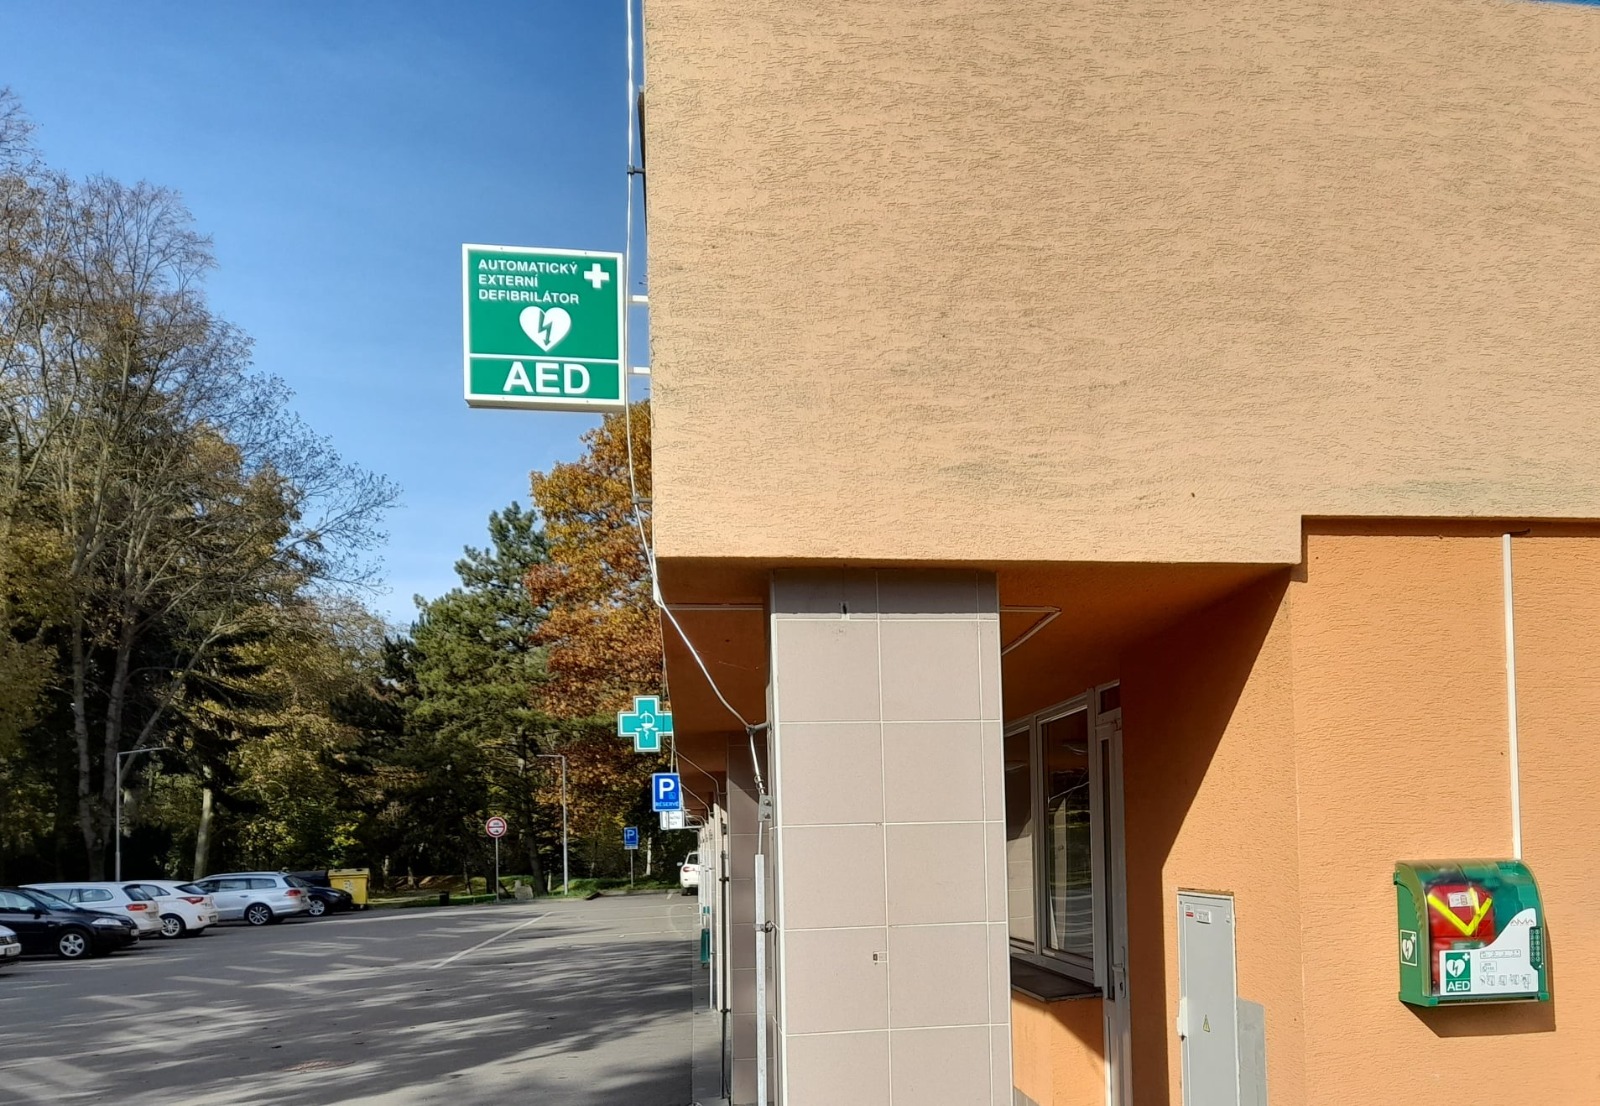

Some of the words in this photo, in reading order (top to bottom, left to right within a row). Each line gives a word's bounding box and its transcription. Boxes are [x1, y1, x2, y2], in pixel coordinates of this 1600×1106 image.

[478, 259, 577, 274] AUTOMATICKÝ
[478, 274, 538, 287] EXTERNÍ
[478, 289, 579, 304] DEFIBRILÁTOR
[502, 361, 590, 394] AED
[659, 778, 675, 799] P
[626, 829, 635, 839] P
[1447, 980, 1470, 991] AED
